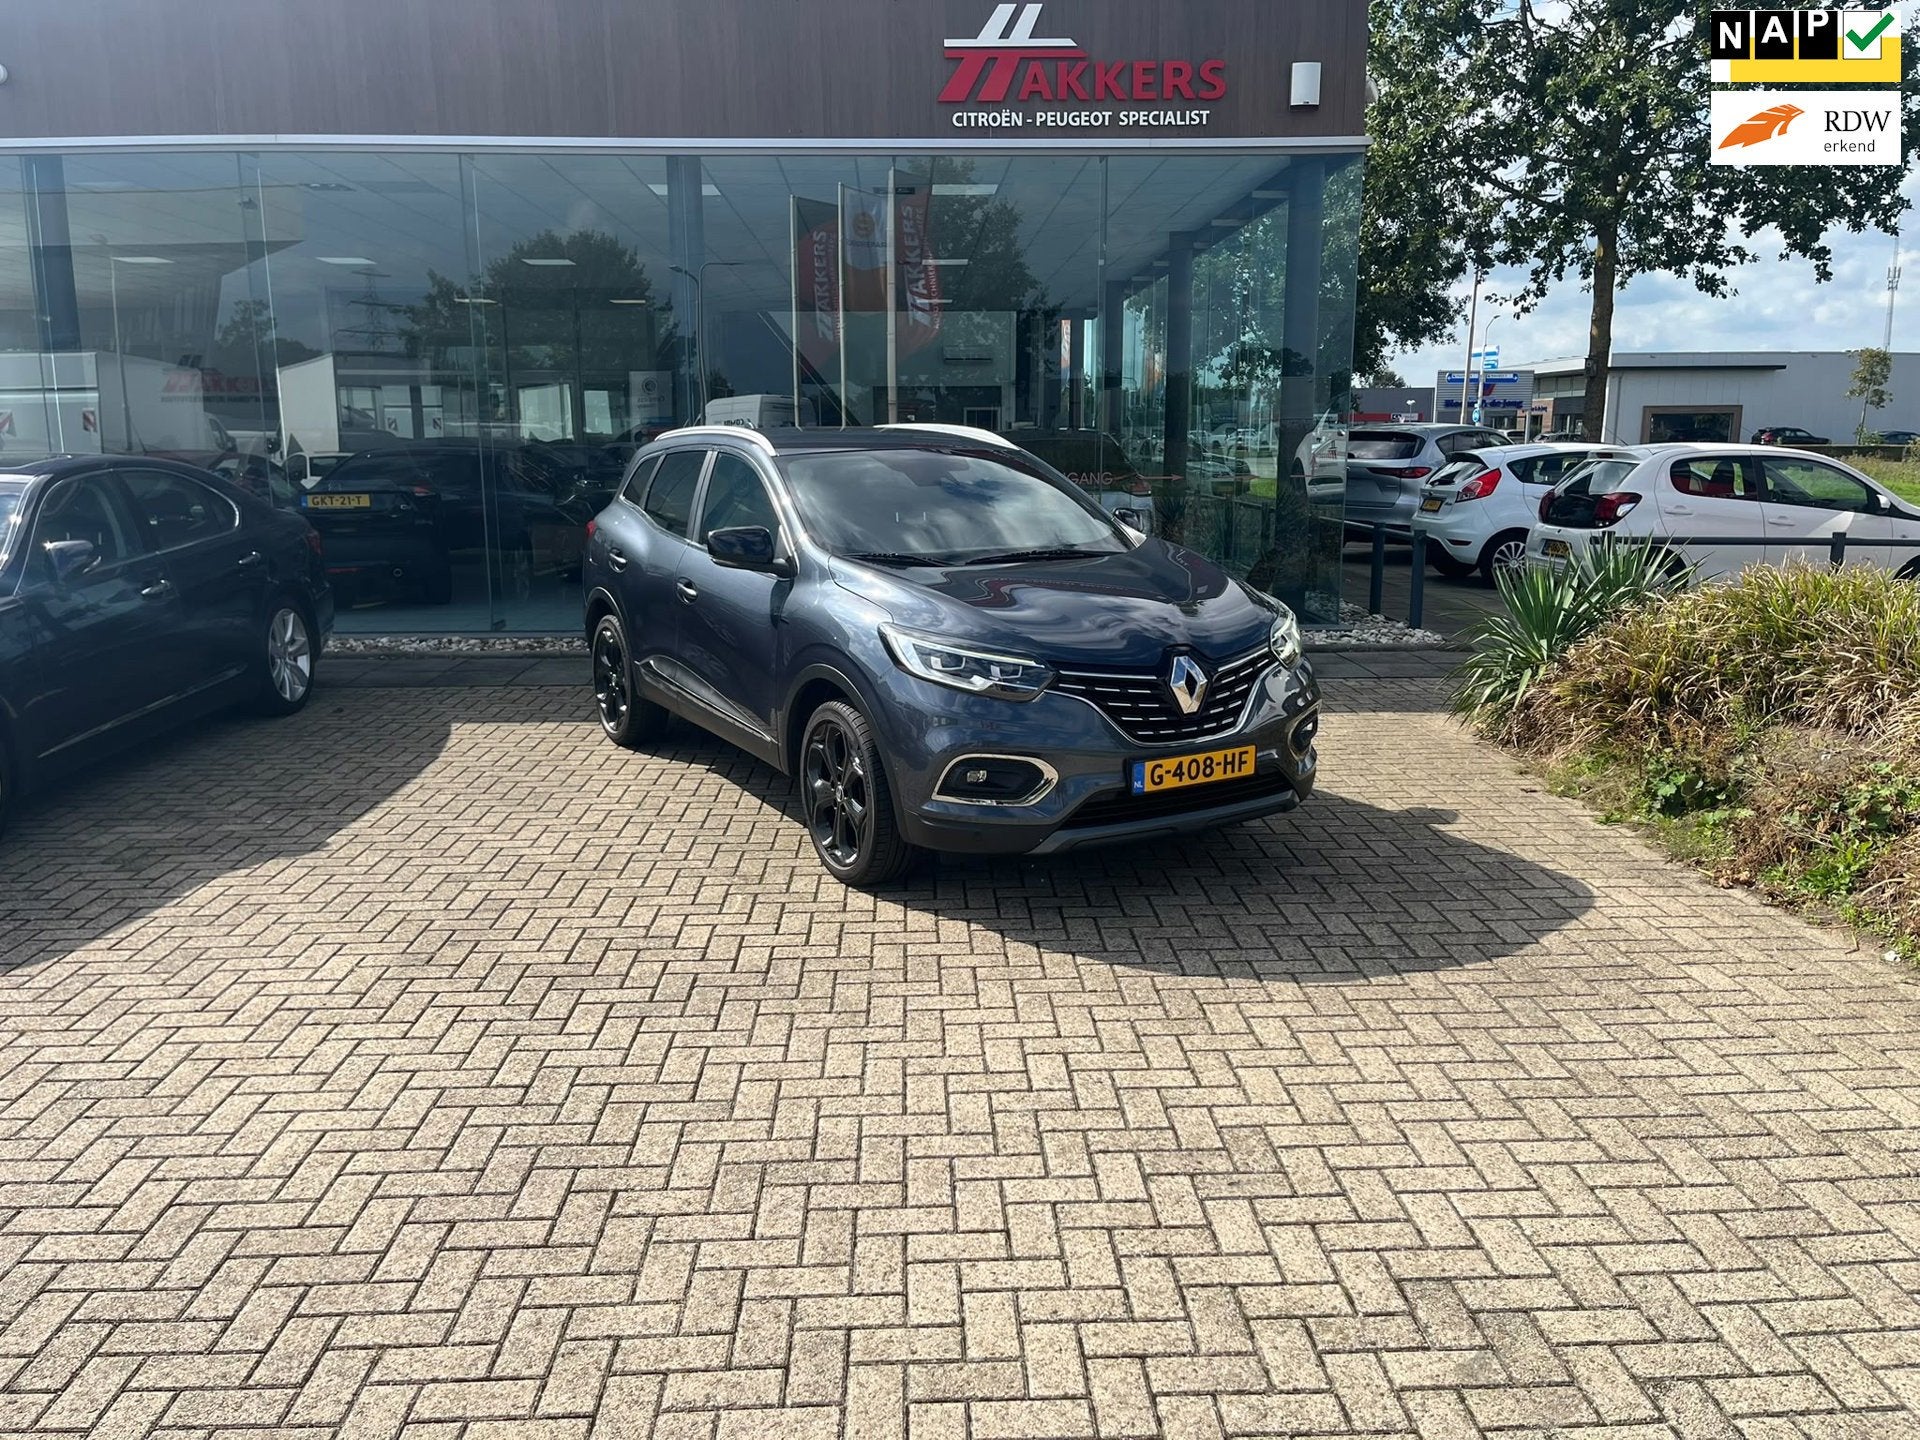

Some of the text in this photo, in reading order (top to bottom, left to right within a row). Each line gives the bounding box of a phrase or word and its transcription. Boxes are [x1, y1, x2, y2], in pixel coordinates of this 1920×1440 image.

[952, 109, 1023, 127] CITROËN
[1036, 111, 1112, 127] PEUGEOT
[1119, 110, 1210, 126] SPECIALIST
[1064, 472, 1113, 485] GANG
[1150, 750, 1249, 786] G-408-HF
